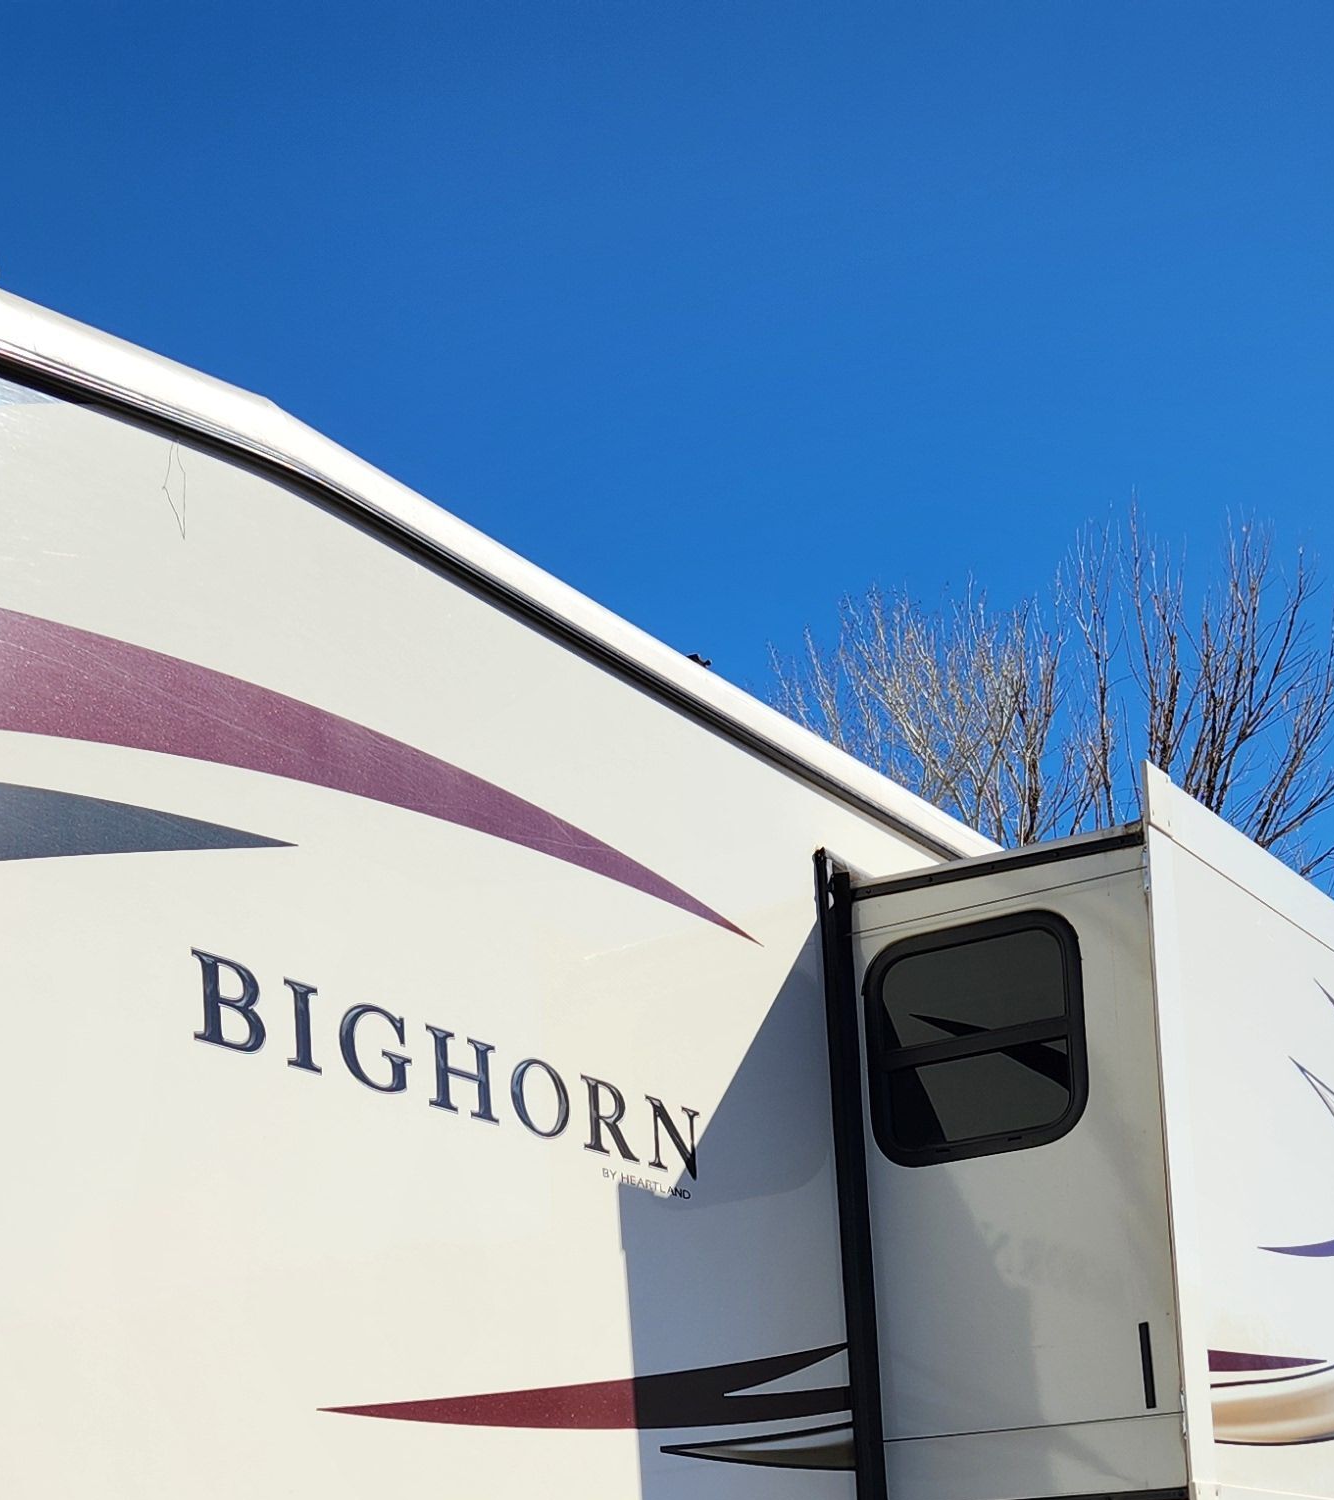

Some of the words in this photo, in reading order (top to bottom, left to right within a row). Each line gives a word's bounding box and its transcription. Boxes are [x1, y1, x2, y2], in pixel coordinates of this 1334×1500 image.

[189, 946, 701, 1181] BIGHORN
[602, 1167, 618, 1180] BY
[620, 1172, 692, 1200] HEARTLAND
